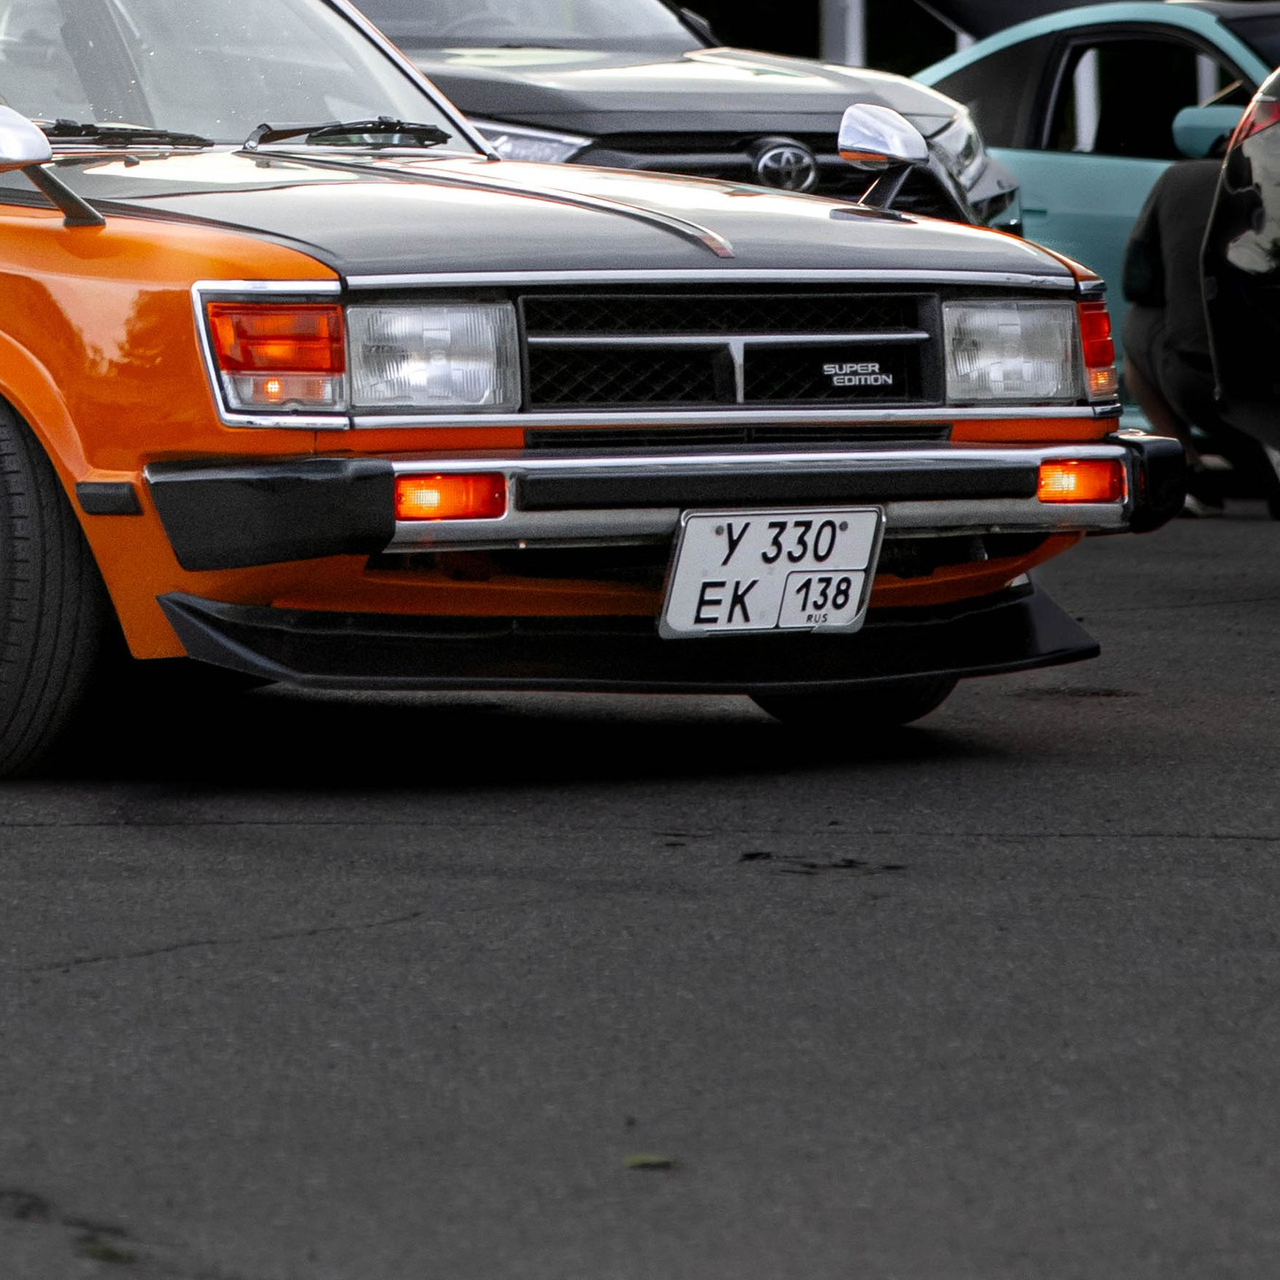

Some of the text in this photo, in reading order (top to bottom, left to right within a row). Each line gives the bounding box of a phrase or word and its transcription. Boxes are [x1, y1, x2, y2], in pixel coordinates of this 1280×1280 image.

[823, 363, 880, 375] SUPER
[832, 374, 893, 386] EDITION
[761, 520, 837, 564] 330
[694, 579, 760, 625] ЕК
[795, 576, 852, 612] 138
[806, 613, 829, 624] RUS
